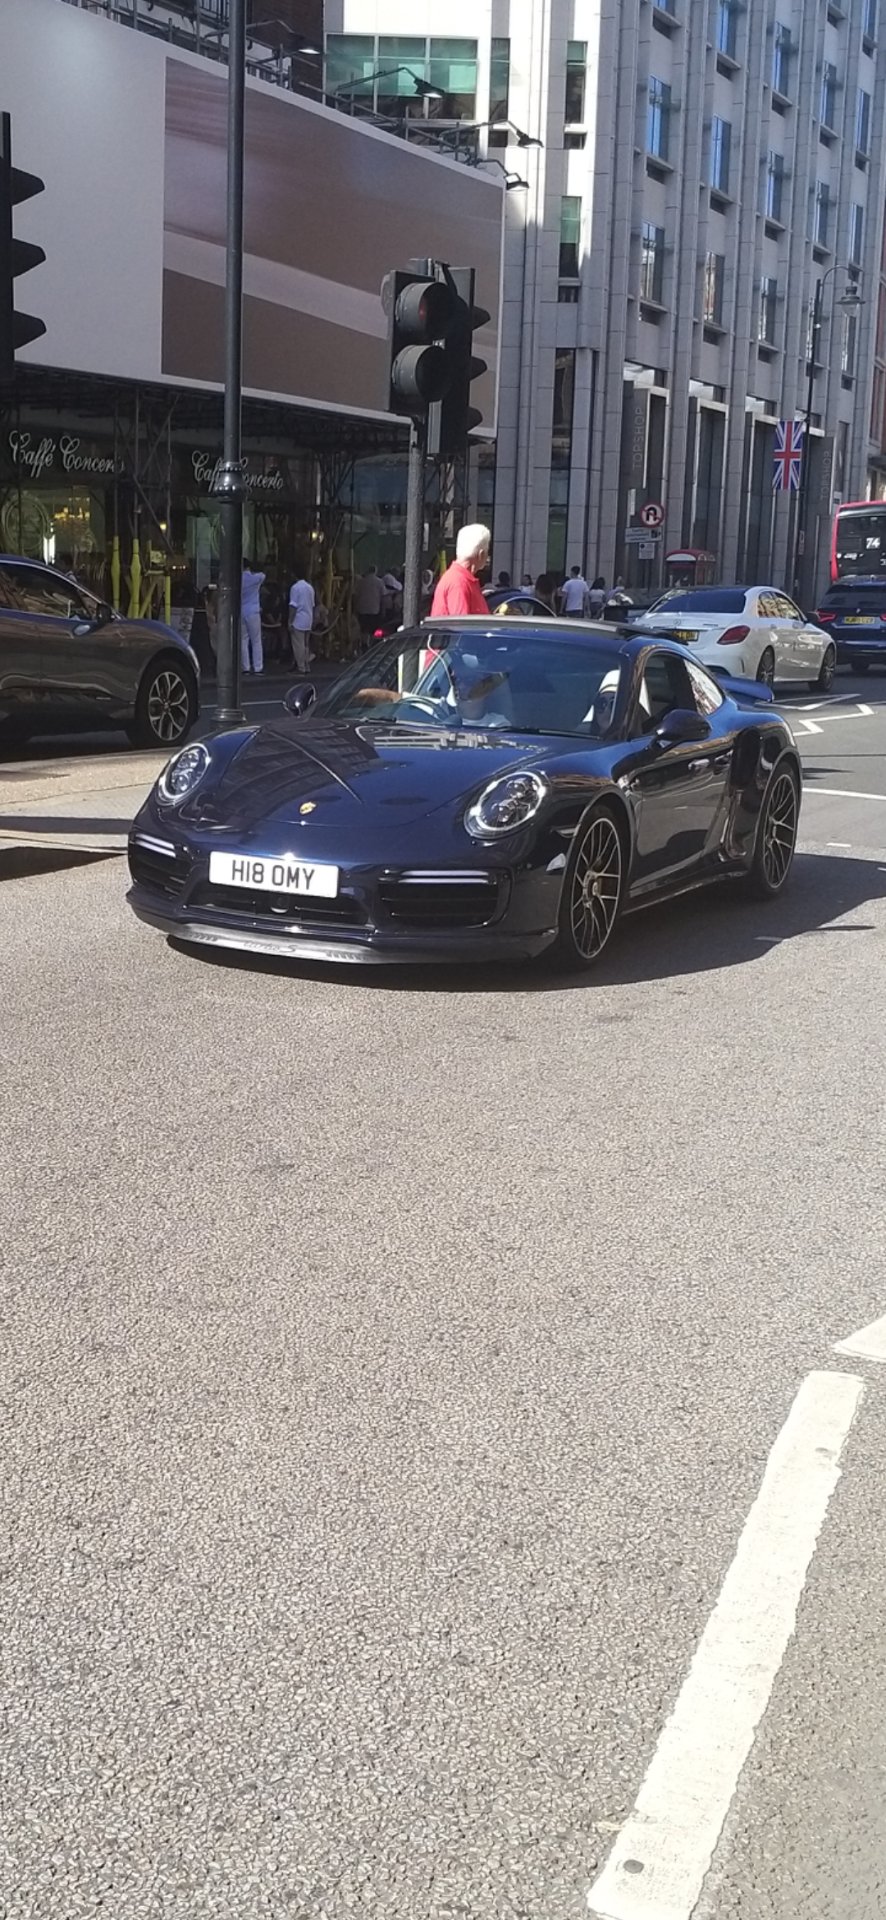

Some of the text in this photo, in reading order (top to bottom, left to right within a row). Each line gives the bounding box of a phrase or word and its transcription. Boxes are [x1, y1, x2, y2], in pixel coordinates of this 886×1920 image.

[9, 430, 56, 478] Caffé
[632, 407, 644, 471] TOPSHOP
[191, 450, 222, 492] Caf
[866, 537, 880, 549] 74
[231, 859, 315, 890] H18 OMY
